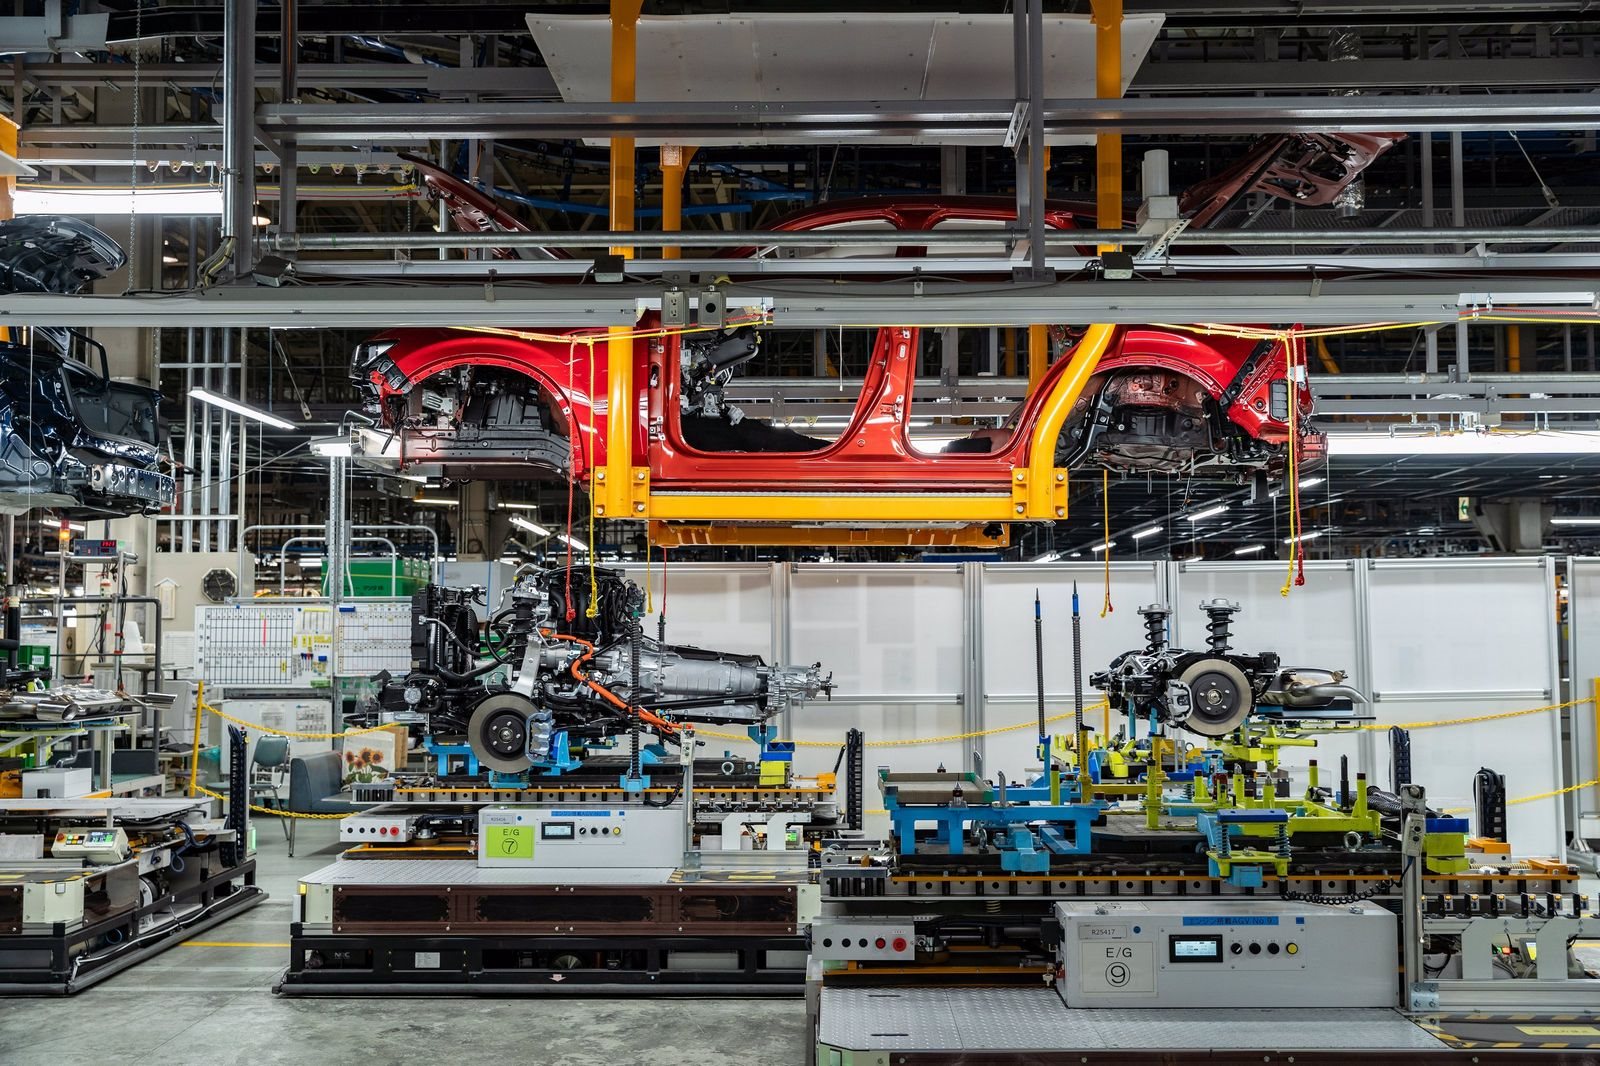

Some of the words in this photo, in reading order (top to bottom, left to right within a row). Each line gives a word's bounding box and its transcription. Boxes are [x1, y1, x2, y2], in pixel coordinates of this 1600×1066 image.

[503, 828, 520, 836] E/G
[334, 951, 351, 959] NC
[1105, 947, 1132, 958] E/G
[1109, 964, 1127, 985] 9
